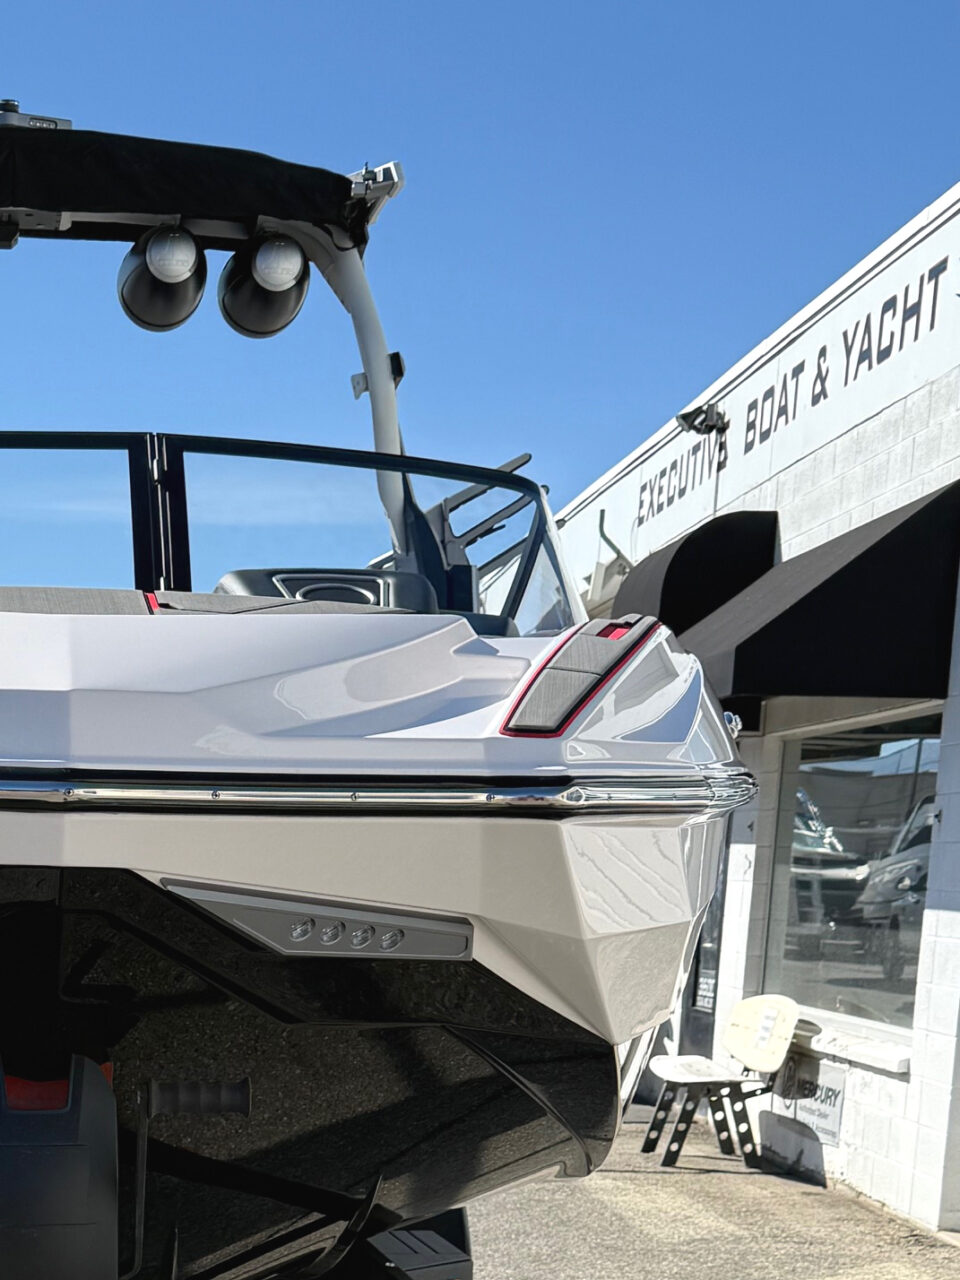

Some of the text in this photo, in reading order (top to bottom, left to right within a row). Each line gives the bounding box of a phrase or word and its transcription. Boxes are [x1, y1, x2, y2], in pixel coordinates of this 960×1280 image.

[744, 358, 806, 455] BOAT
[811, 344, 829, 407] &
[842, 254, 949, 388] YACHT
